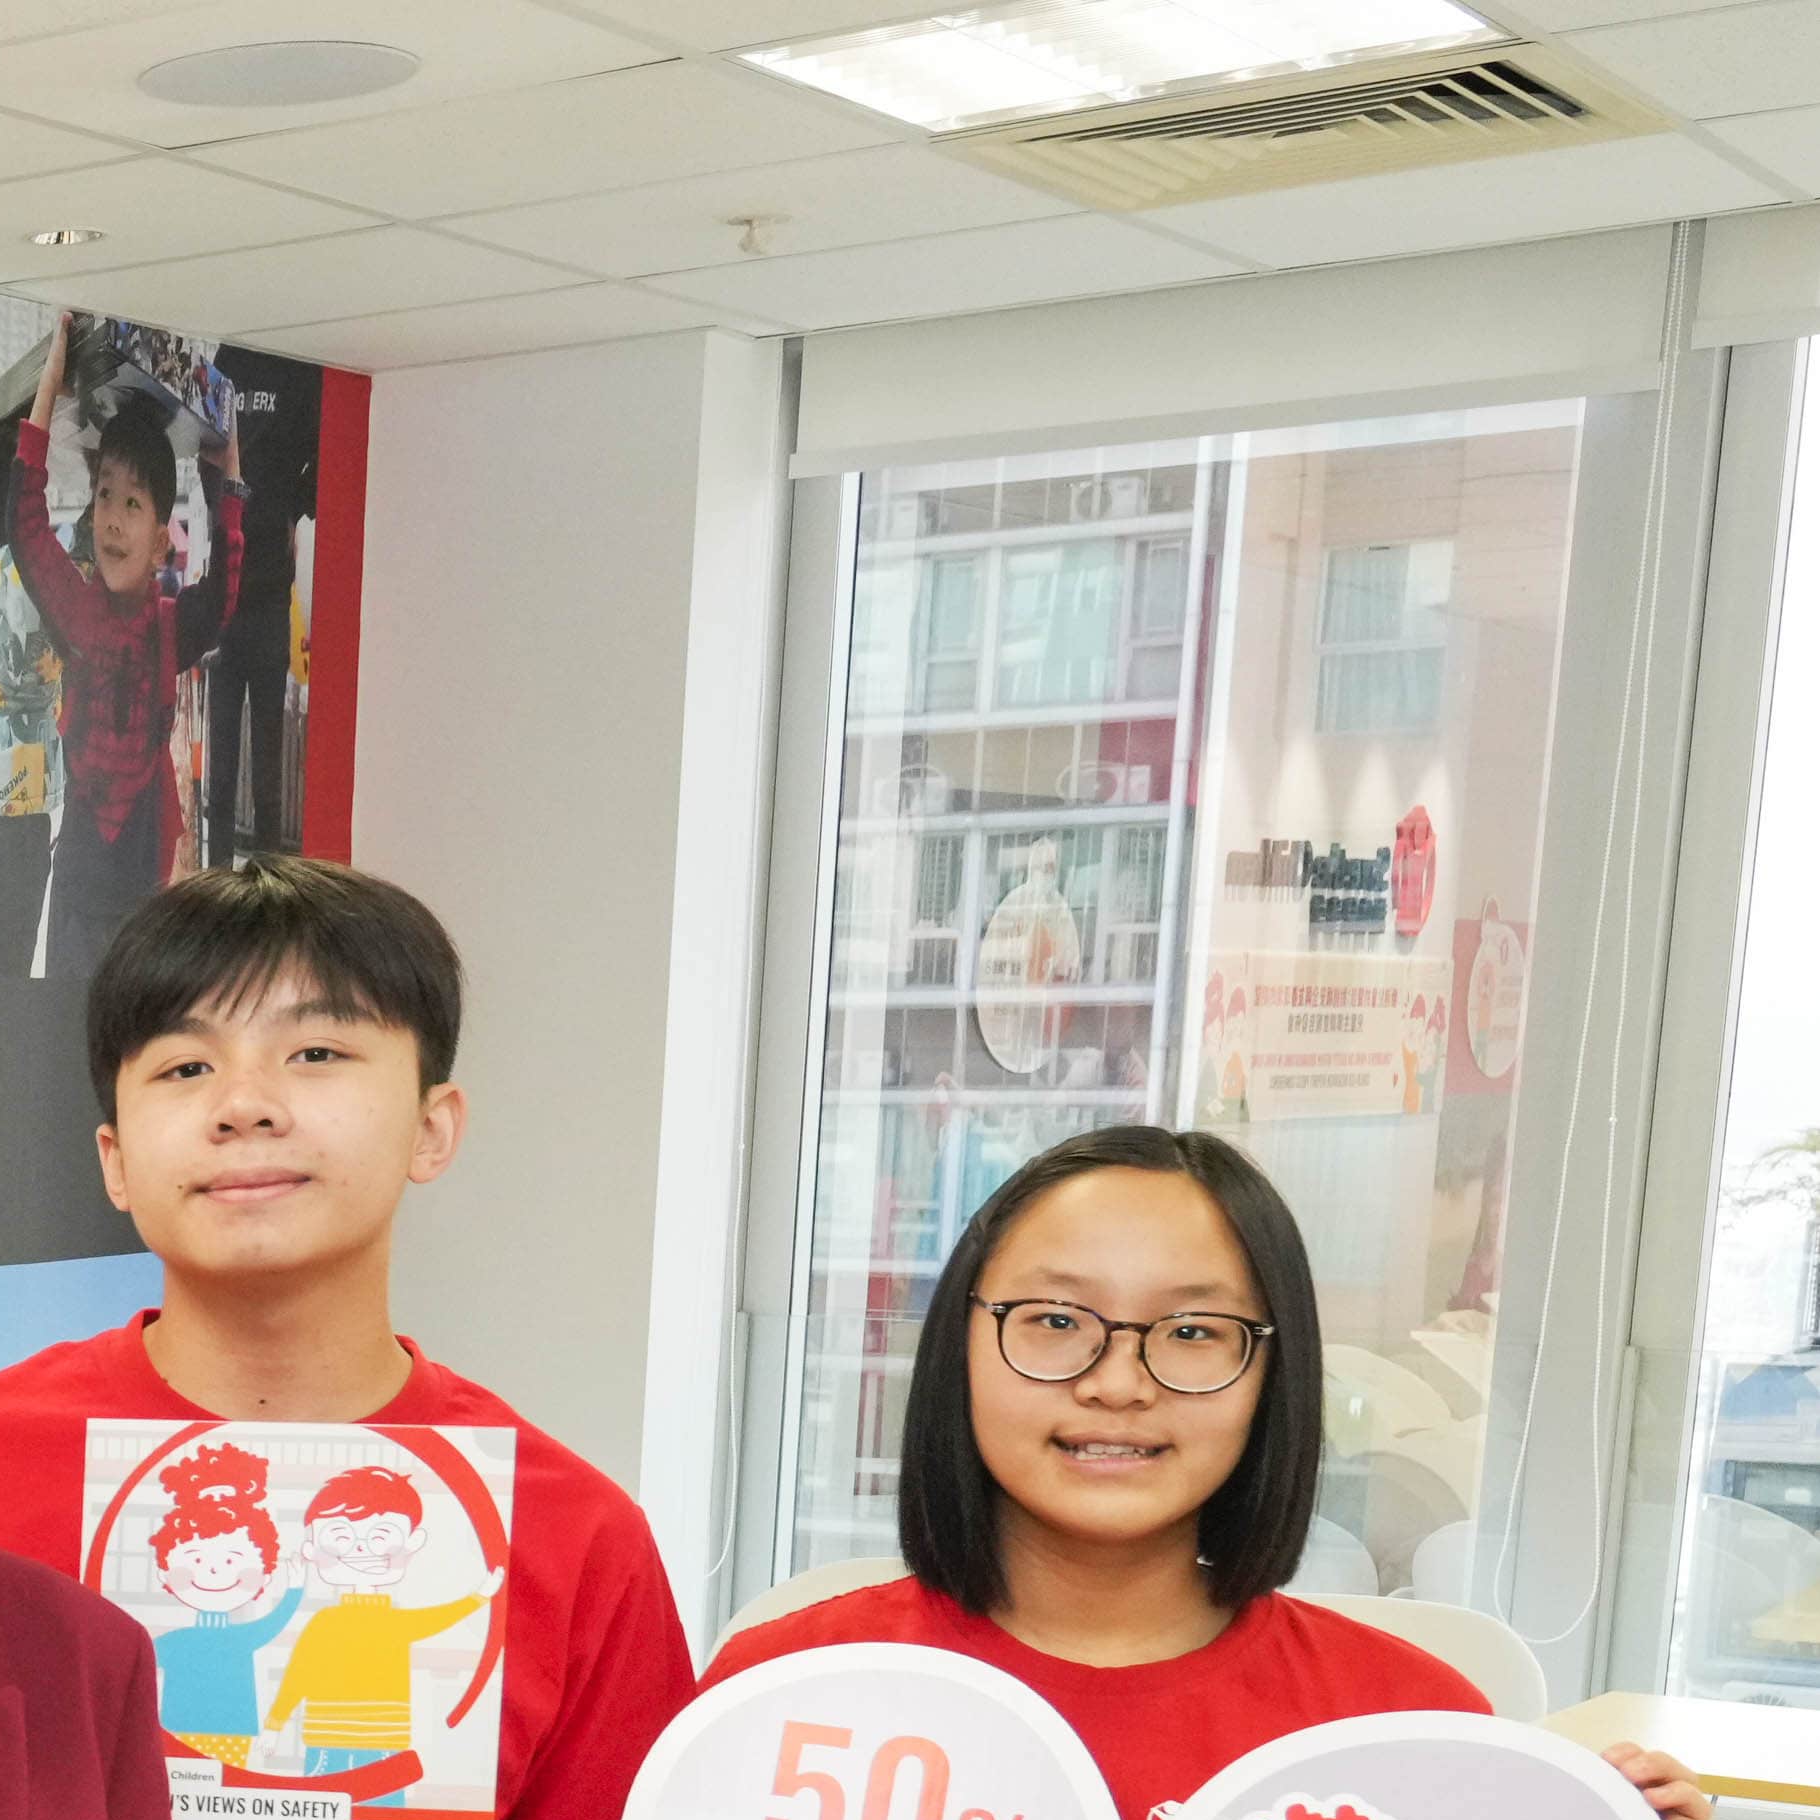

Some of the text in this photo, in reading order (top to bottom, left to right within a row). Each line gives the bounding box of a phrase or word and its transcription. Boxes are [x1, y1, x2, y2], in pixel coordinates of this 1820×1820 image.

[171, 1770, 215, 1782] Children
[196, 1795, 245, 1815] VIEWS
[252, 1798, 274, 1816] ON
[281, 1800, 339, 1819] SAFETY
